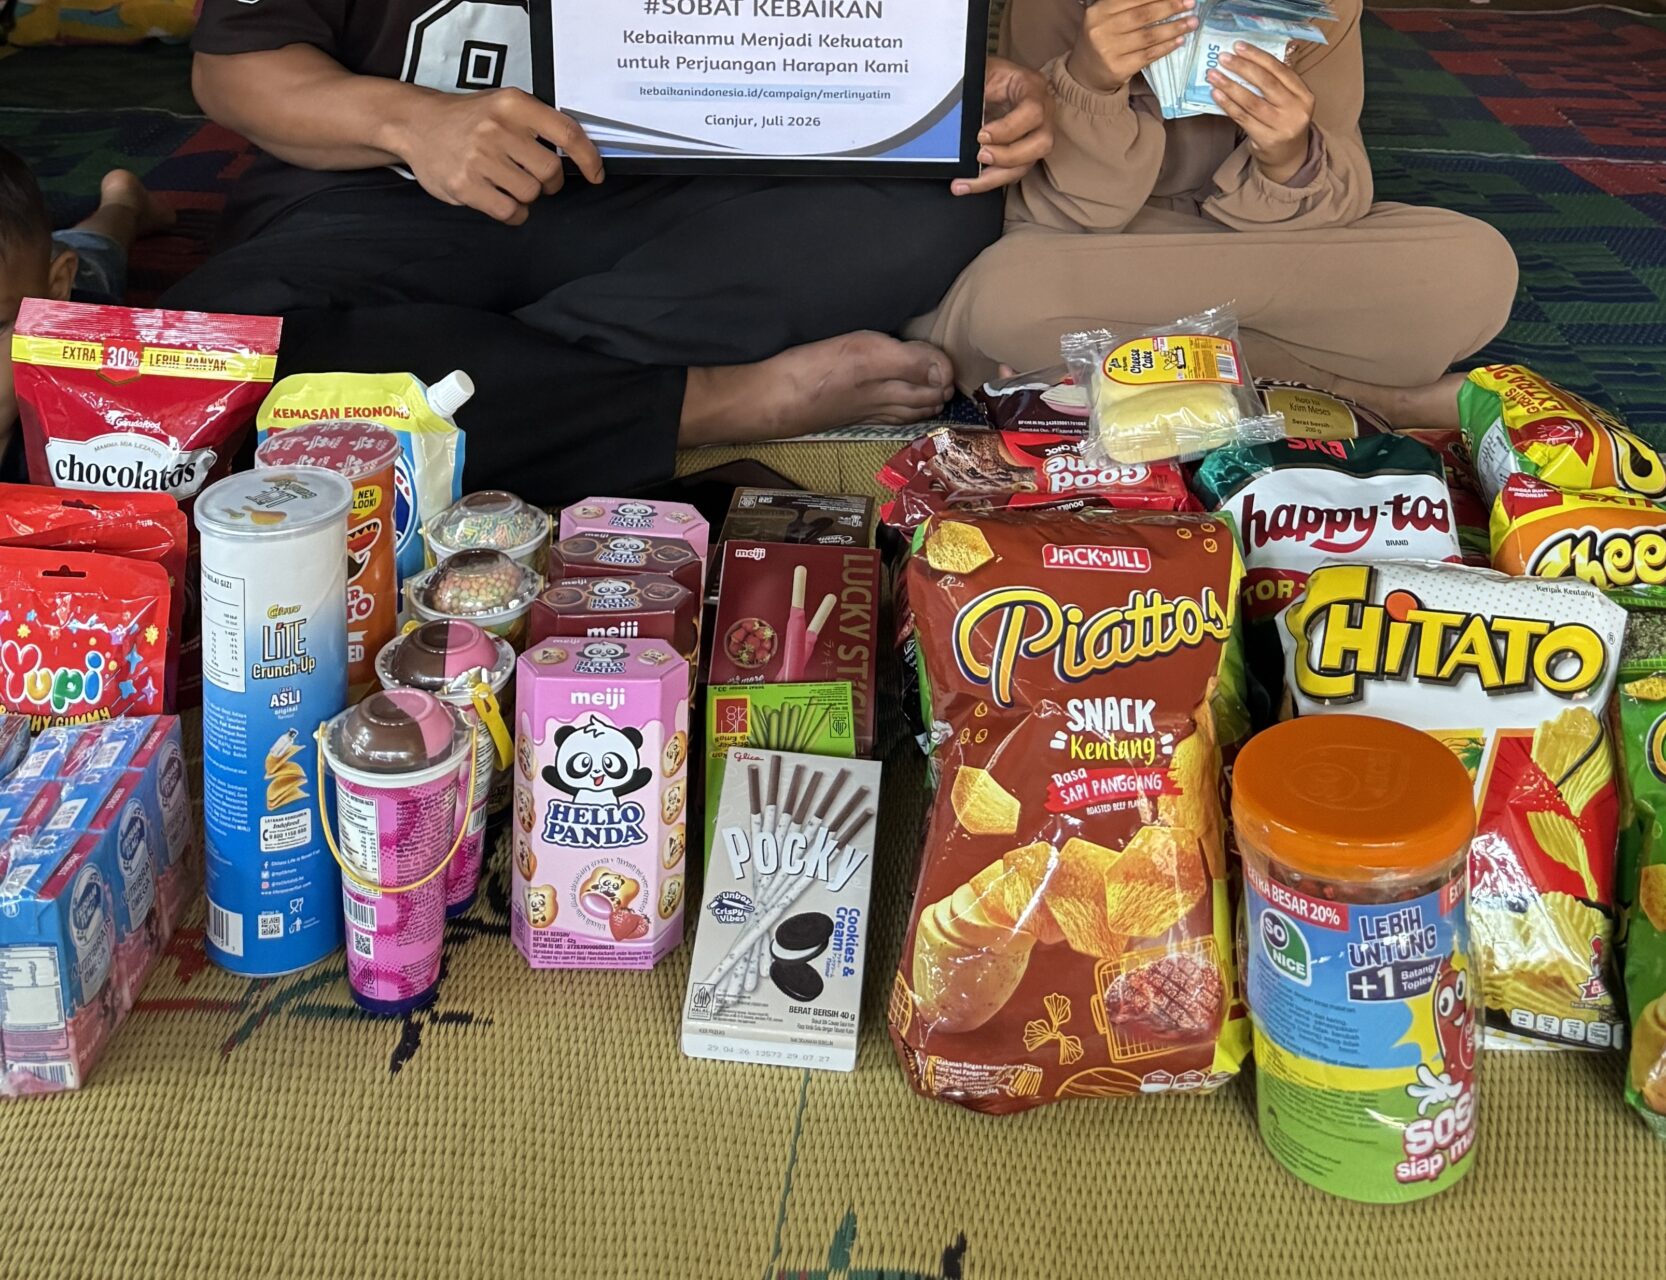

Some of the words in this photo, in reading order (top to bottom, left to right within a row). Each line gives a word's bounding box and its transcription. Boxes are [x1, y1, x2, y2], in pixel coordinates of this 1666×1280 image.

[623, 30, 735, 47] Kebaikanmu
[741, 31, 813, 50] Menjadi
[818, 33, 903, 49] Kekuatan
[617, 55, 670, 70] untuk
[676, 55, 777, 74] Perjuangan
[782, 58, 858, 76] Harapan
[864, 58, 909, 74] Kami
[639, 86, 891, 101] kebaikanindonesia.id/campaign/merlinyatim
[704, 114, 758, 128] Cianjur,
[761, 114, 784, 128] Juli
[787, 115, 821, 127] 2026
[62, 346, 96, 361] EXTRA
[107, 346, 139, 367] 30%
[1129, 348, 1142, 374] Cheese
[1142, 350, 1153, 369] Cake
[273, 407, 341, 420] KEMASAN
[1051, 463, 1148, 493] Good
[358, 489, 375, 499] NEW
[735, 547, 766, 560] meiji
[1385, 539, 1409, 547] BRAND
[839, 553, 874, 642] LUCKY
[587, 621, 639, 638] meiji
[953, 587, 1232, 707] Piattos
[1, 640, 105, 713] Yupi
[270, 689, 301, 708] ASLI
[570, 688, 625, 710] meiji
[1066, 696, 1156, 733] SNACK
[1070, 734, 1156, 766] Kentang
[1051, 768, 1088, 788] Rasa
[1060, 783, 1089, 805] SAPI
[1091, 773, 1163, 796] PANGGANG
[549, 803, 641, 826] HELLO
[1086, 802, 1112, 815] ROASTED
[1113, 801, 1127, 811] BEEF
[545, 822, 644, 845] PANDA
[722, 892, 751, 905] Unbox
[1271, 882, 1308, 917] BESAR
[1310, 903, 1340, 926] 20%
[832, 906, 848, 951] Cream
[844, 907, 861, 959] Cookies
[1264, 916, 1286, 941] SO
[1348, 924, 1437, 968] UNTUNG
[842, 966, 855, 977] &
[1272, 948, 1306, 977] NICE
[1353, 967, 1396, 999] +1
[1402, 974, 1433, 992] Toples
[789, 1005, 811, 1015] BERAT
[813, 1008, 839, 1018] BERSIH
[1396, 1153, 1444, 1180] siap
